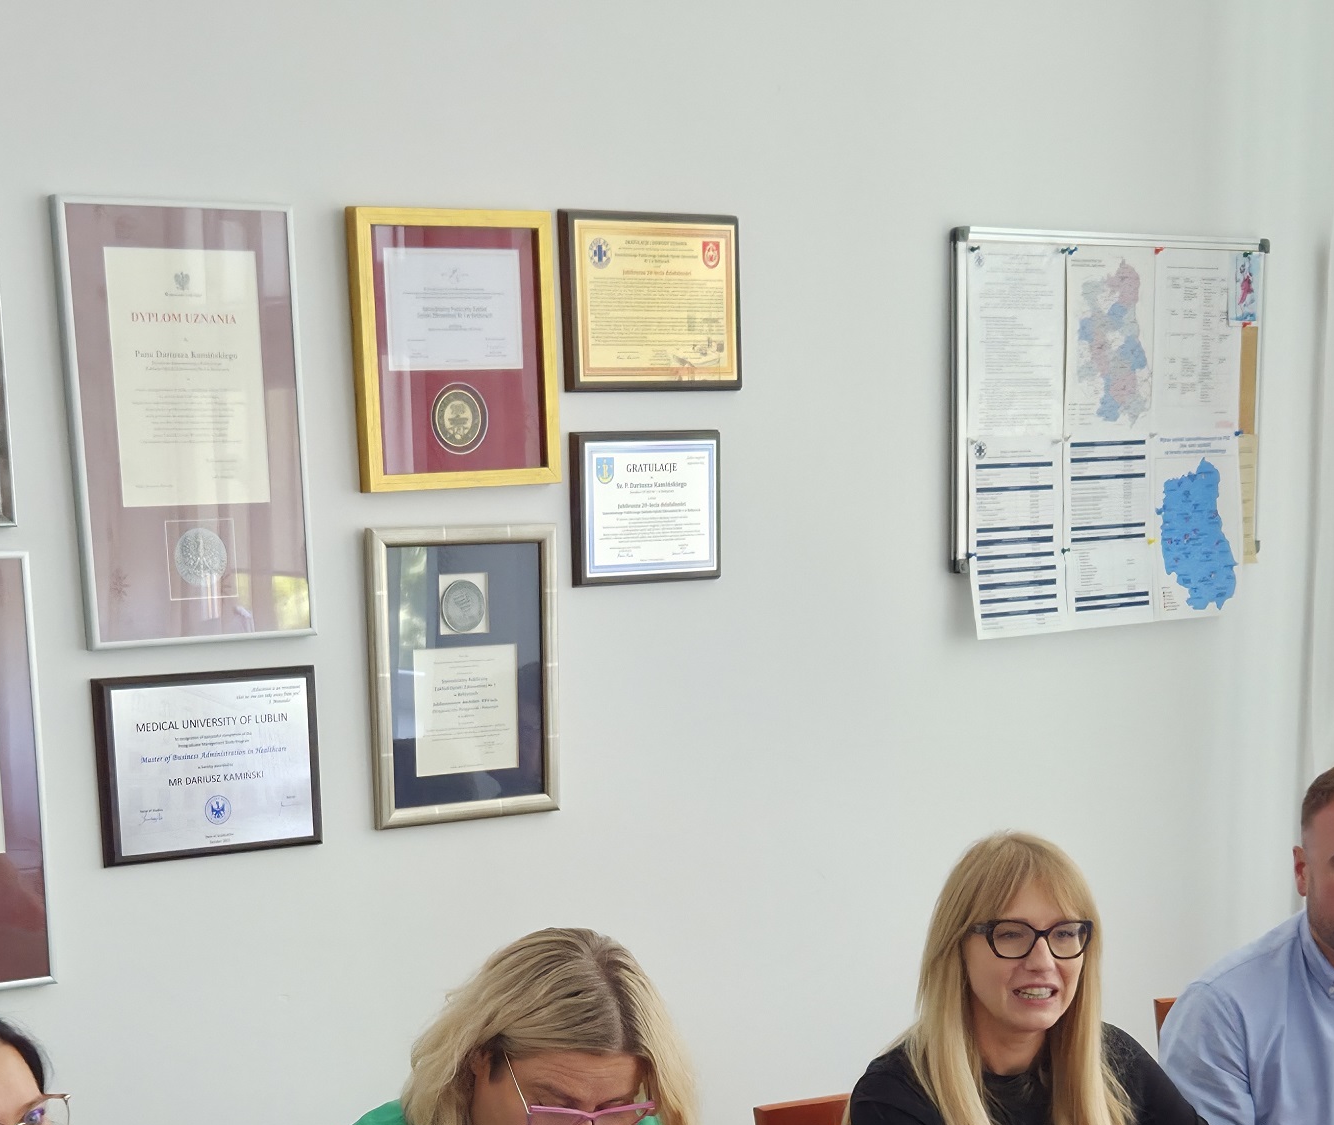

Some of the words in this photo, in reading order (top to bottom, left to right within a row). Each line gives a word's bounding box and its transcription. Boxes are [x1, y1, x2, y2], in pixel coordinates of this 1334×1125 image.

[131, 311, 182, 323] DYPLOM
[185, 313, 237, 324] UZNANIA
[626, 463, 677, 473] GRATULACJE
[136, 721, 179, 733] MEDICAL
[182, 716, 237, 730] UNIVERSITY
[240, 715, 252, 725] OF
[255, 713, 288, 724] LUBLIN
[141, 756, 163, 764] Master
[164, 754, 172, 764] of
[200, 749, 246, 760] Administration
[255, 746, 287, 754] Healthcare
[168, 778, 183, 786] MR
[185, 774, 221, 785] DARIUSZ
[223, 770, 264, 782] KAMIŃSKI
